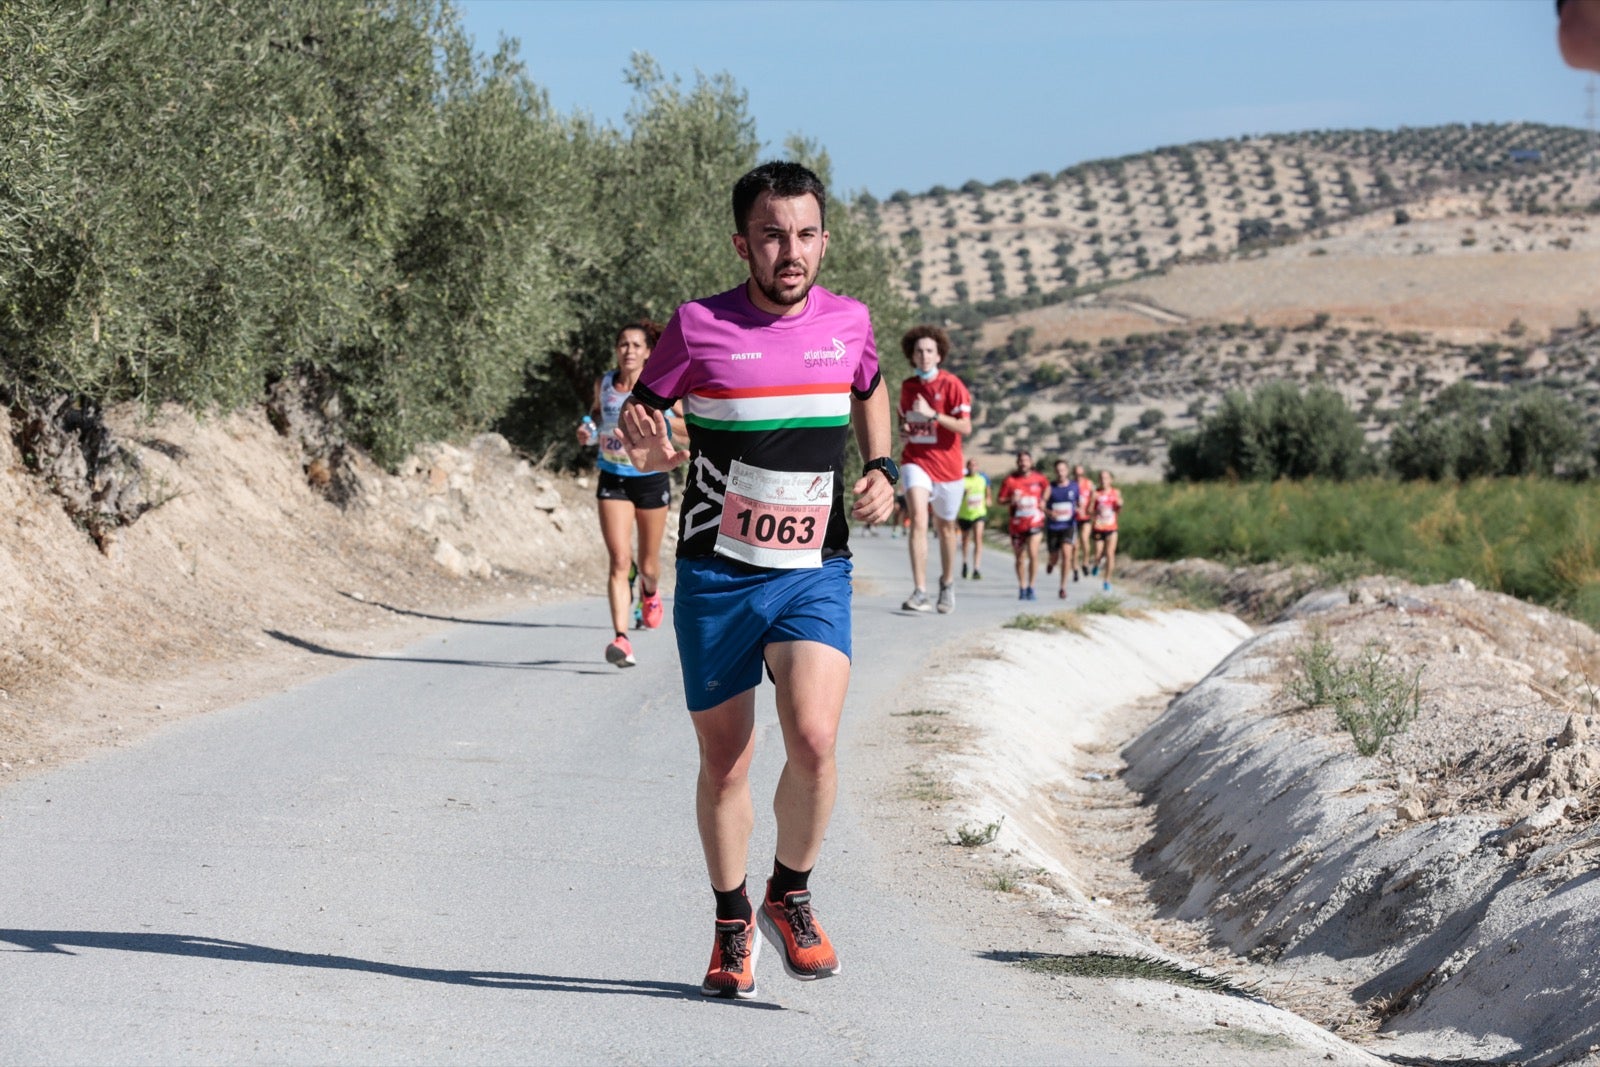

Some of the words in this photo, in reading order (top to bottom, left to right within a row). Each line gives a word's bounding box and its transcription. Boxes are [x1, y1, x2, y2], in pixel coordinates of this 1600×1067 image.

[731, 352, 762, 360] FASTER
[804, 357, 838, 368] SANTA
[737, 509, 816, 544] 1063
